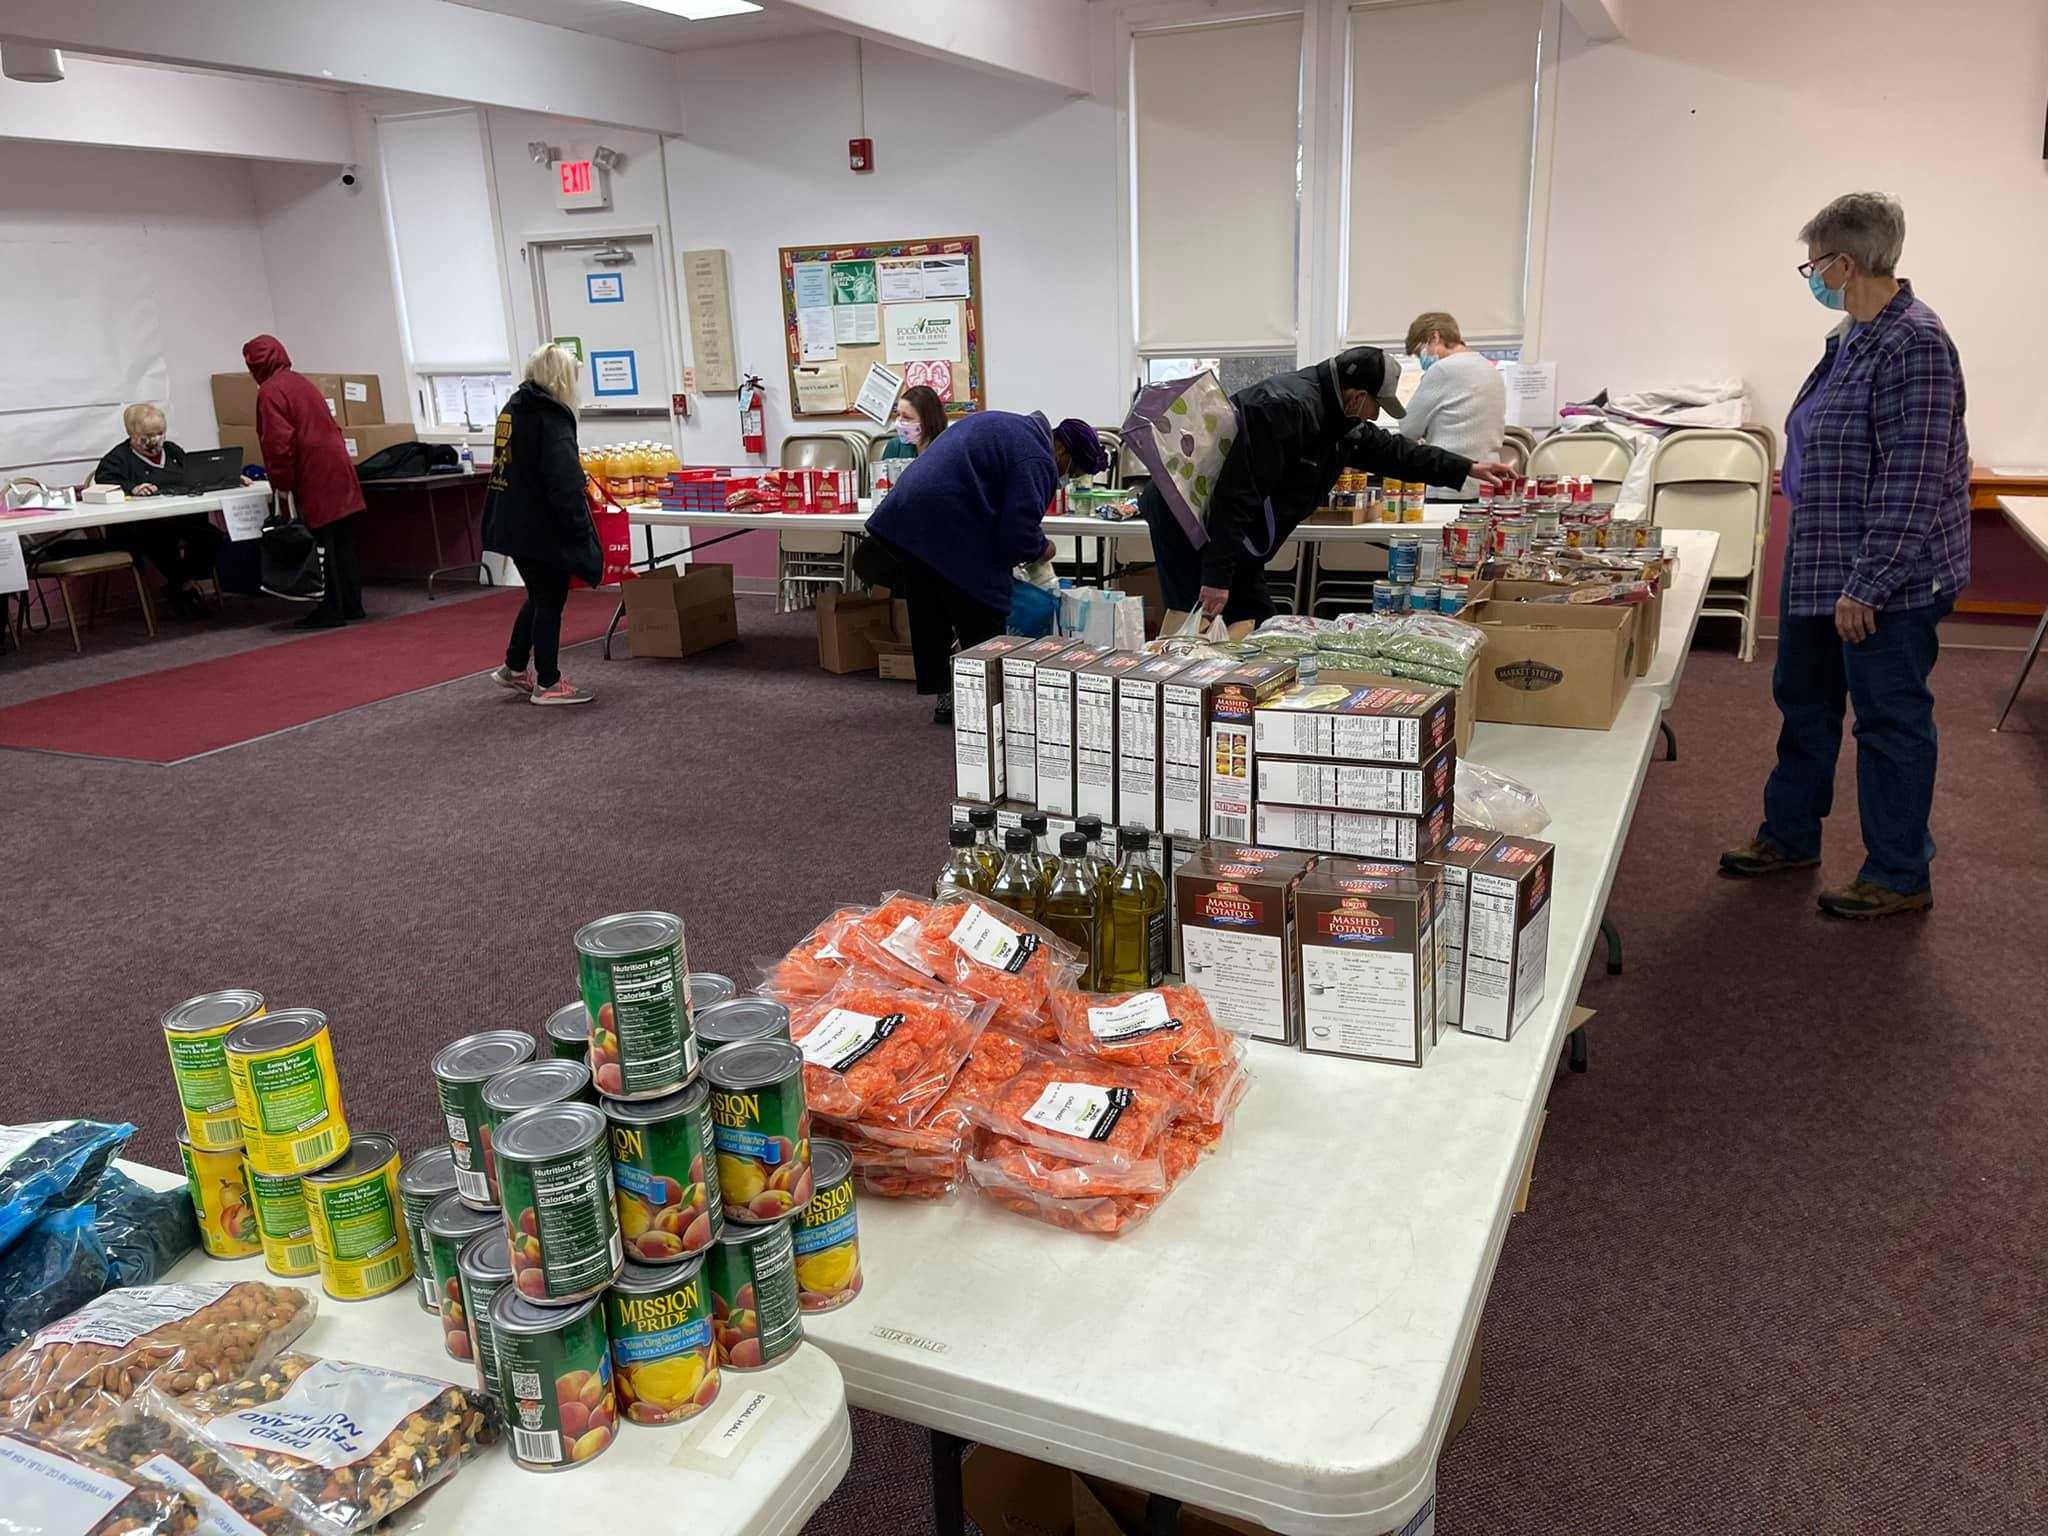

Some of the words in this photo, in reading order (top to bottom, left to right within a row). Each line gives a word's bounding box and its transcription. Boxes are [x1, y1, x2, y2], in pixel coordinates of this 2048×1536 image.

[560, 161, 591, 194] EXIT
[1500, 668, 1529, 678] MARKET
[1532, 669, 1558, 680] STREET
[1216, 704, 1250, 715] POTATOES
[1218, 698, 1248, 708] MASHED
[1208, 898, 1250, 910] MASHED
[1206, 906, 1254, 920] POTATOES
[1330, 923, 1384, 936] POTATOES
[1332, 916, 1380, 927] MASHED
[613, 962, 648, 972] Nutrition
[650, 956, 668, 968] Facts
[662, 980, 673, 992] 60
[617, 992, 651, 1000] Calories
[268, 1060, 286, 1070] Eating
[286, 1056, 300, 1066] Well
[257, 1067, 282, 1076] Couldn't
[710, 1092, 758, 1122] SSION
[712, 1112, 746, 1128] RIDE
[534, 1164, 571, 1177] Nutrition
[573, 1156, 592, 1169] Facts
[358, 1185, 370, 1194] Well
[586, 1180, 596, 1192] 60
[329, 1196, 354, 1204] Couldn't
[539, 1193, 574, 1204] Calories
[806, 1204, 847, 1227] PRIDE
[754, 1234, 780, 1253] Nutrition
[757, 1261, 784, 1278] Calories
[470, 1286, 497, 1295] Nutritio
[618, 1281, 698, 1326] MISSION
[638, 1310, 688, 1332] PRIDE
[638, 1346, 660, 1356] EXTRA
[660, 1342, 680, 1352] LIGHT
[682, 1333, 704, 1346] SYRUP
[644, 1337, 662, 1348] Cling
[662, 1331, 682, 1346] Sliced
[740, 1394, 766, 1418] SOCIAL
[238, 1412, 293, 1428] AND
[320, 1413, 364, 1437] NUT
[723, 1420, 744, 1438] HALL
[250, 1427, 312, 1449] DRIED
[288, 1426, 358, 1453] FRUIT
